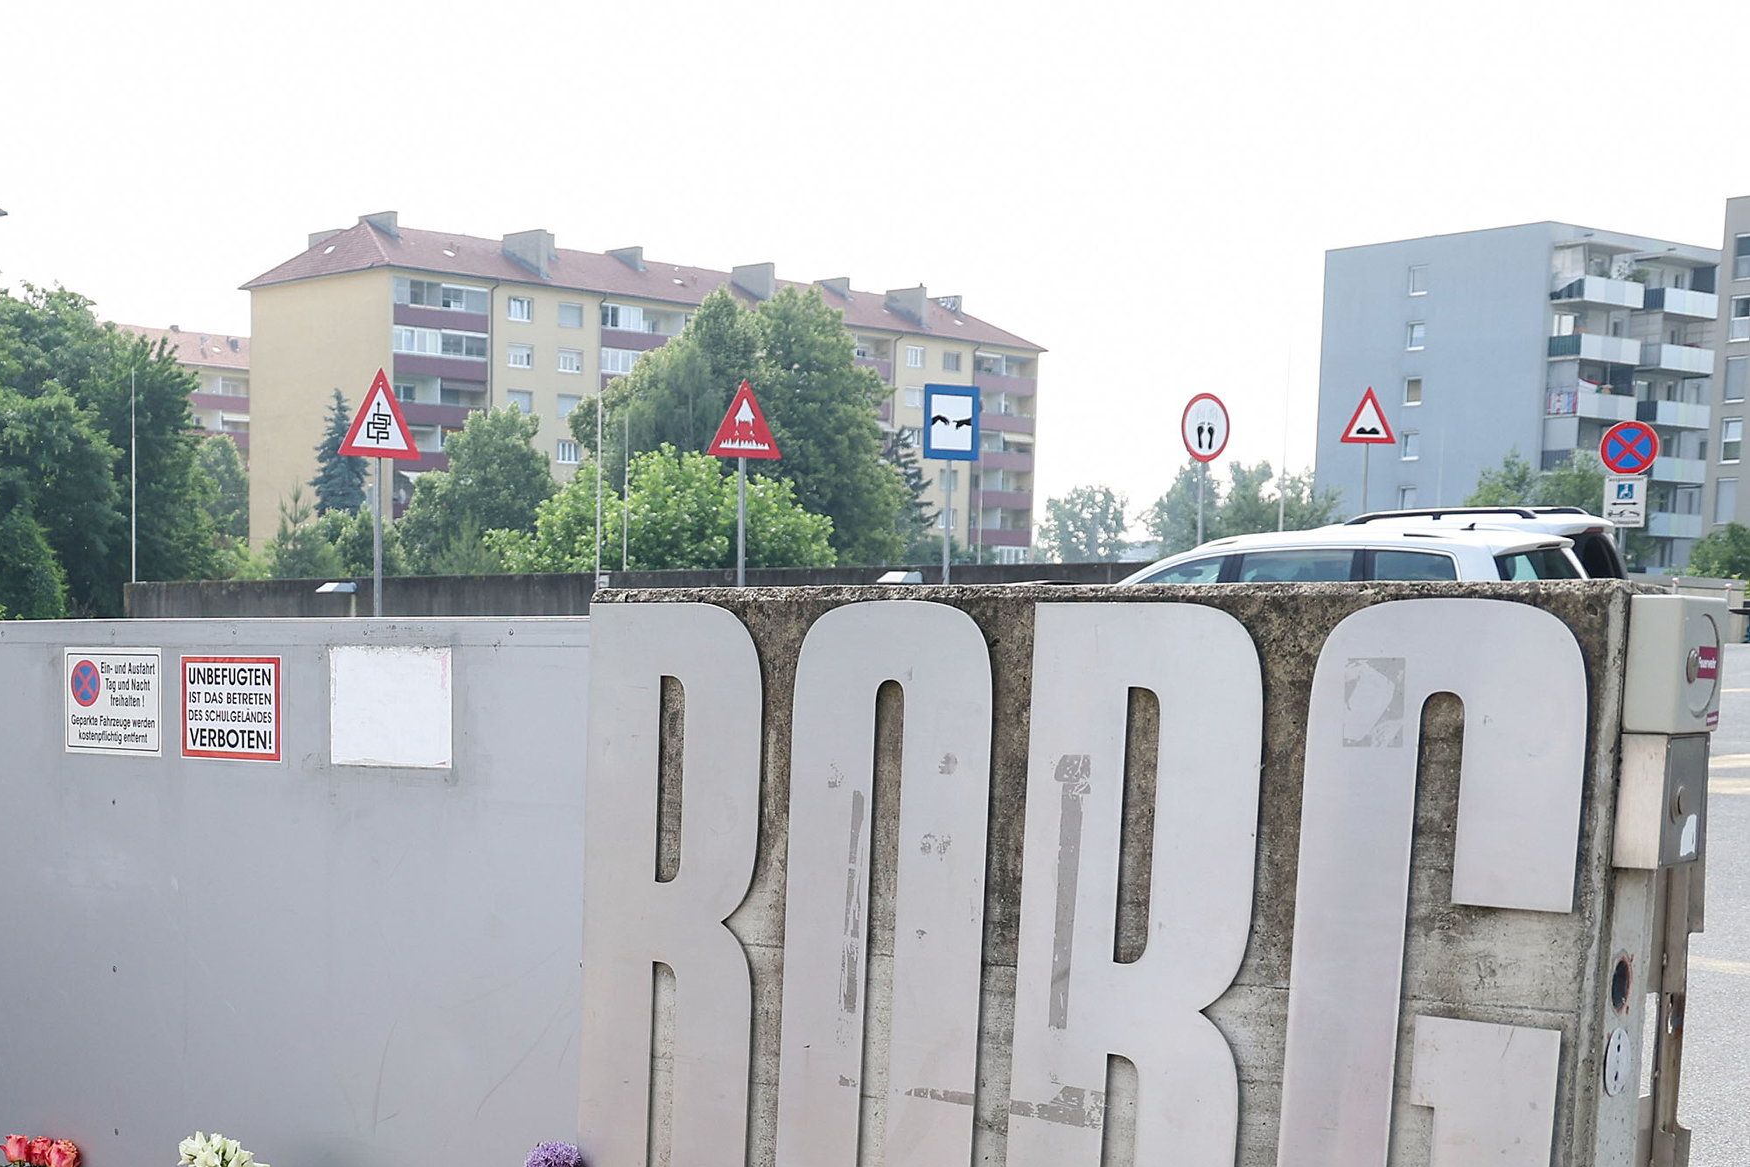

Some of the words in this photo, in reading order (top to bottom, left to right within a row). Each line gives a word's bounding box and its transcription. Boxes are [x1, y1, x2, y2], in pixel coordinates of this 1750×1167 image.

[101, 662, 113, 674] Ein-
[115, 662, 126, 674] und
[128, 662, 155, 675] Ausfahrt
[188, 667, 271, 686] UNBEFUGTEN
[105, 678, 116, 692] Tag
[118, 679, 129, 691] und
[131, 679, 150, 691] Nacht
[110, 694, 140, 707] freihalten
[189, 692, 201, 703] IST
[204, 692, 223, 704] DAS
[226, 692, 271, 705] BETRETEN
[71, 714, 98, 728] Geparkte
[99, 716, 130, 730] Fahrzeuge
[132, 718, 156, 728] werden
[188, 709, 203, 720] DES
[205, 707, 272, 723] SCHULGELÄNDES
[78, 730, 123, 744] kostenpflichtig
[124, 732, 148, 743] entfernt
[190, 728, 272, 749] VERBOTEN!
